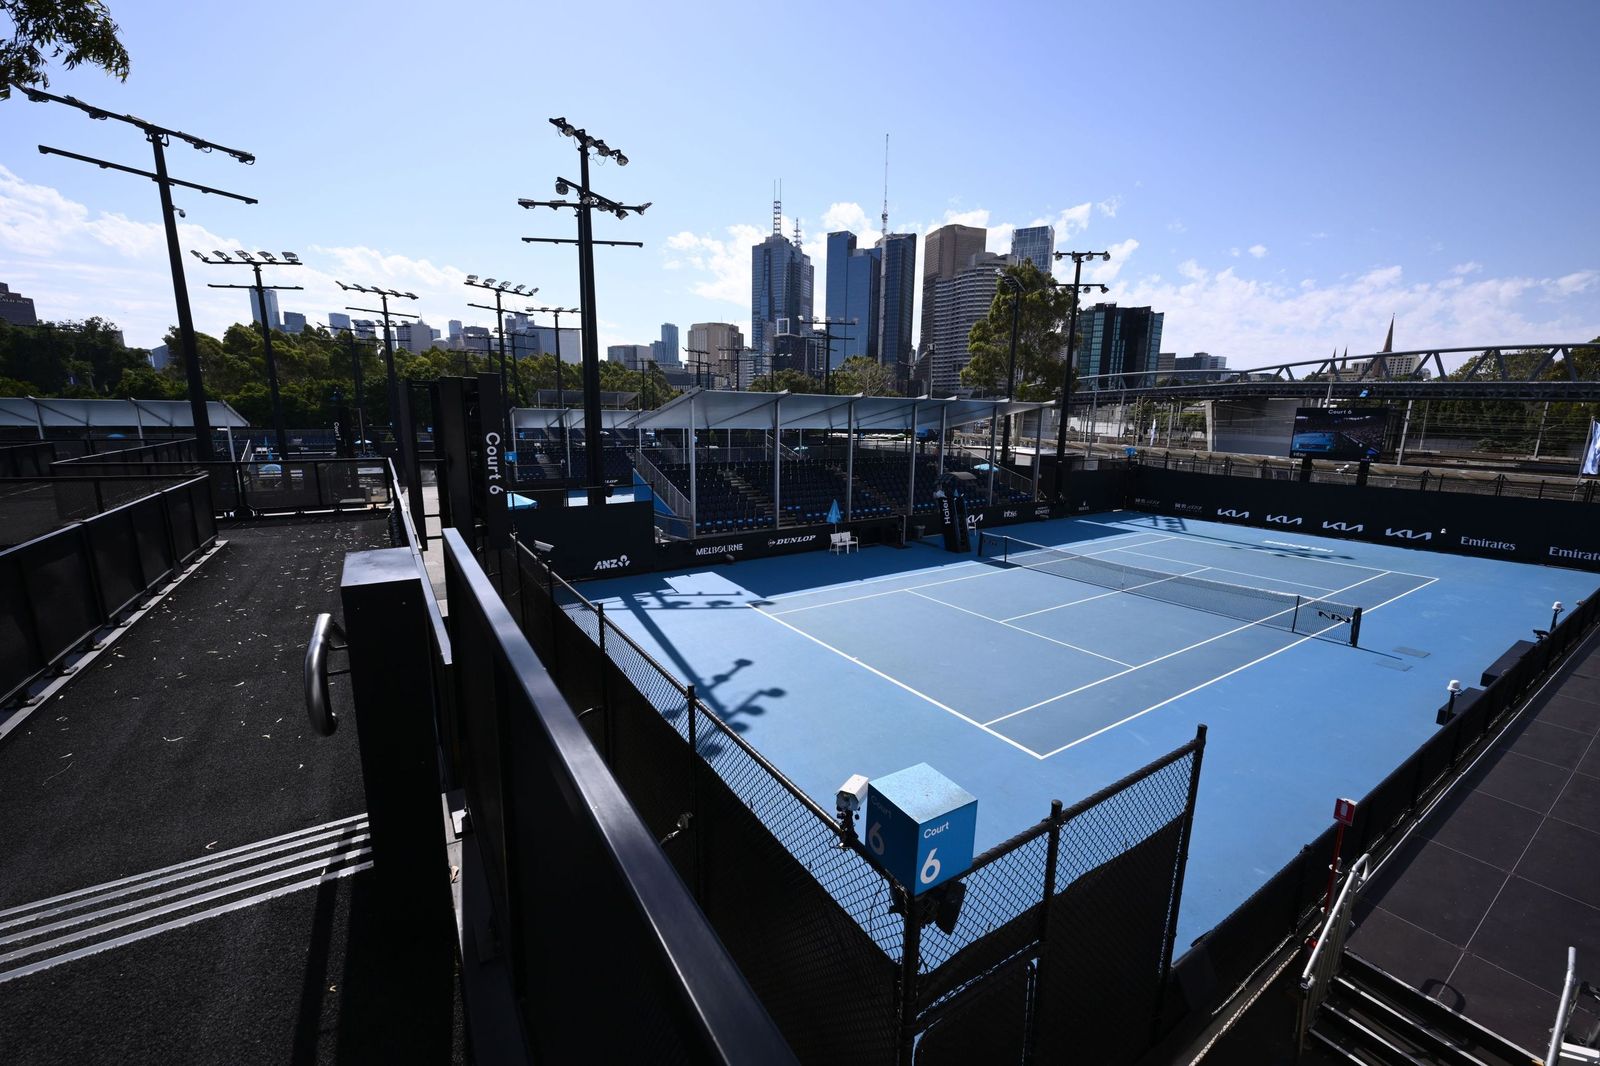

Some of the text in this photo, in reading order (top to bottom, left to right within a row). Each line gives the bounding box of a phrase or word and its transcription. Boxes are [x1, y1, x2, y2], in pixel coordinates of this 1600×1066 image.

[485, 432, 504, 495] Court 6
[776, 534, 817, 545] DUNLOP
[1460, 536, 1516, 551] Emirates
[695, 543, 743, 556] MELBOURNE
[593, 558, 618, 570] ANZ
[923, 821, 950, 839] Court
[868, 822, 885, 856] 6
[920, 847, 941, 885] 6
